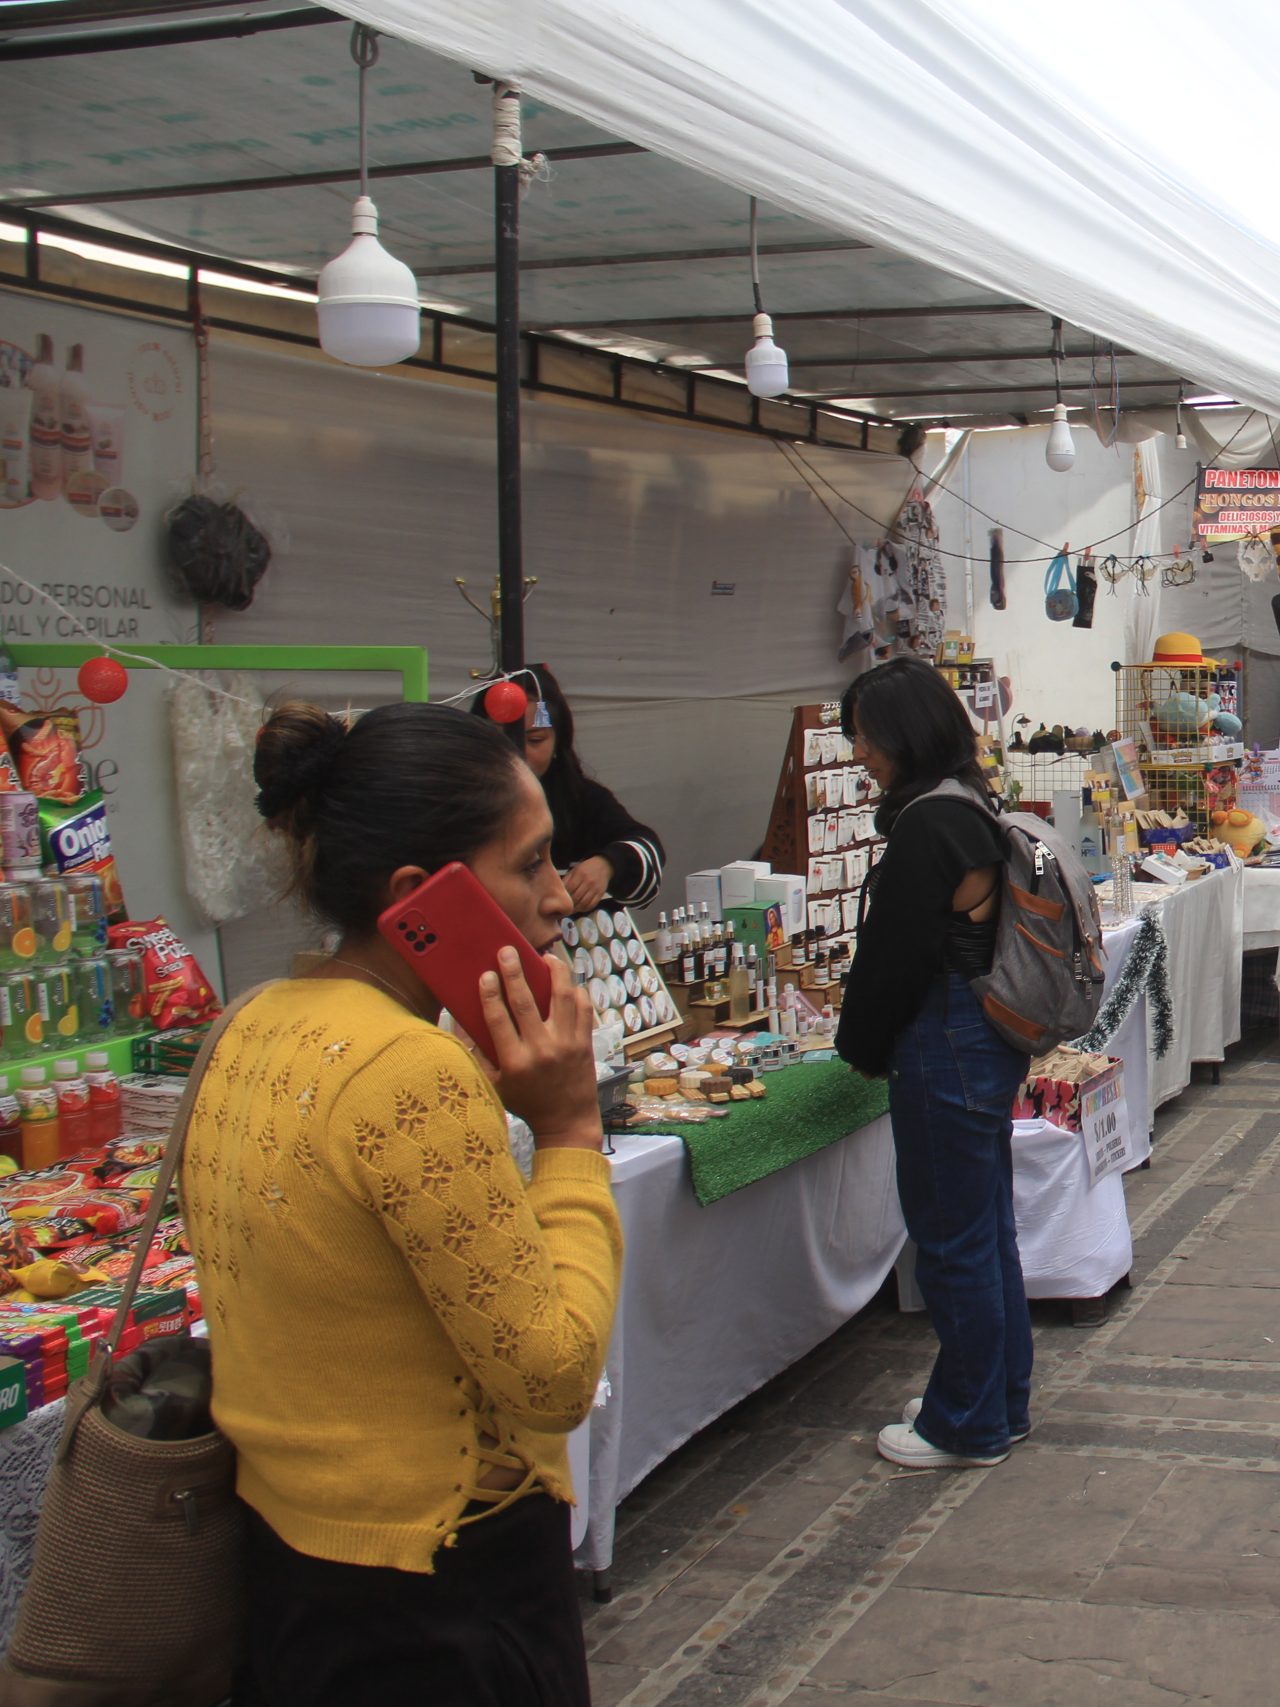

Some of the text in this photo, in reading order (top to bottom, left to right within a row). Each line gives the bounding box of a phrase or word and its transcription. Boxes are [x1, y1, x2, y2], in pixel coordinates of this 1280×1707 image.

[1219, 511, 1274, 522] DELICIOSOS
[1199, 524, 1250, 535] VITAMINAS
[41, 583, 153, 610] PERSONAL
[37, 616, 50, 636] Y
[55, 616, 139, 638] CAPILAR
